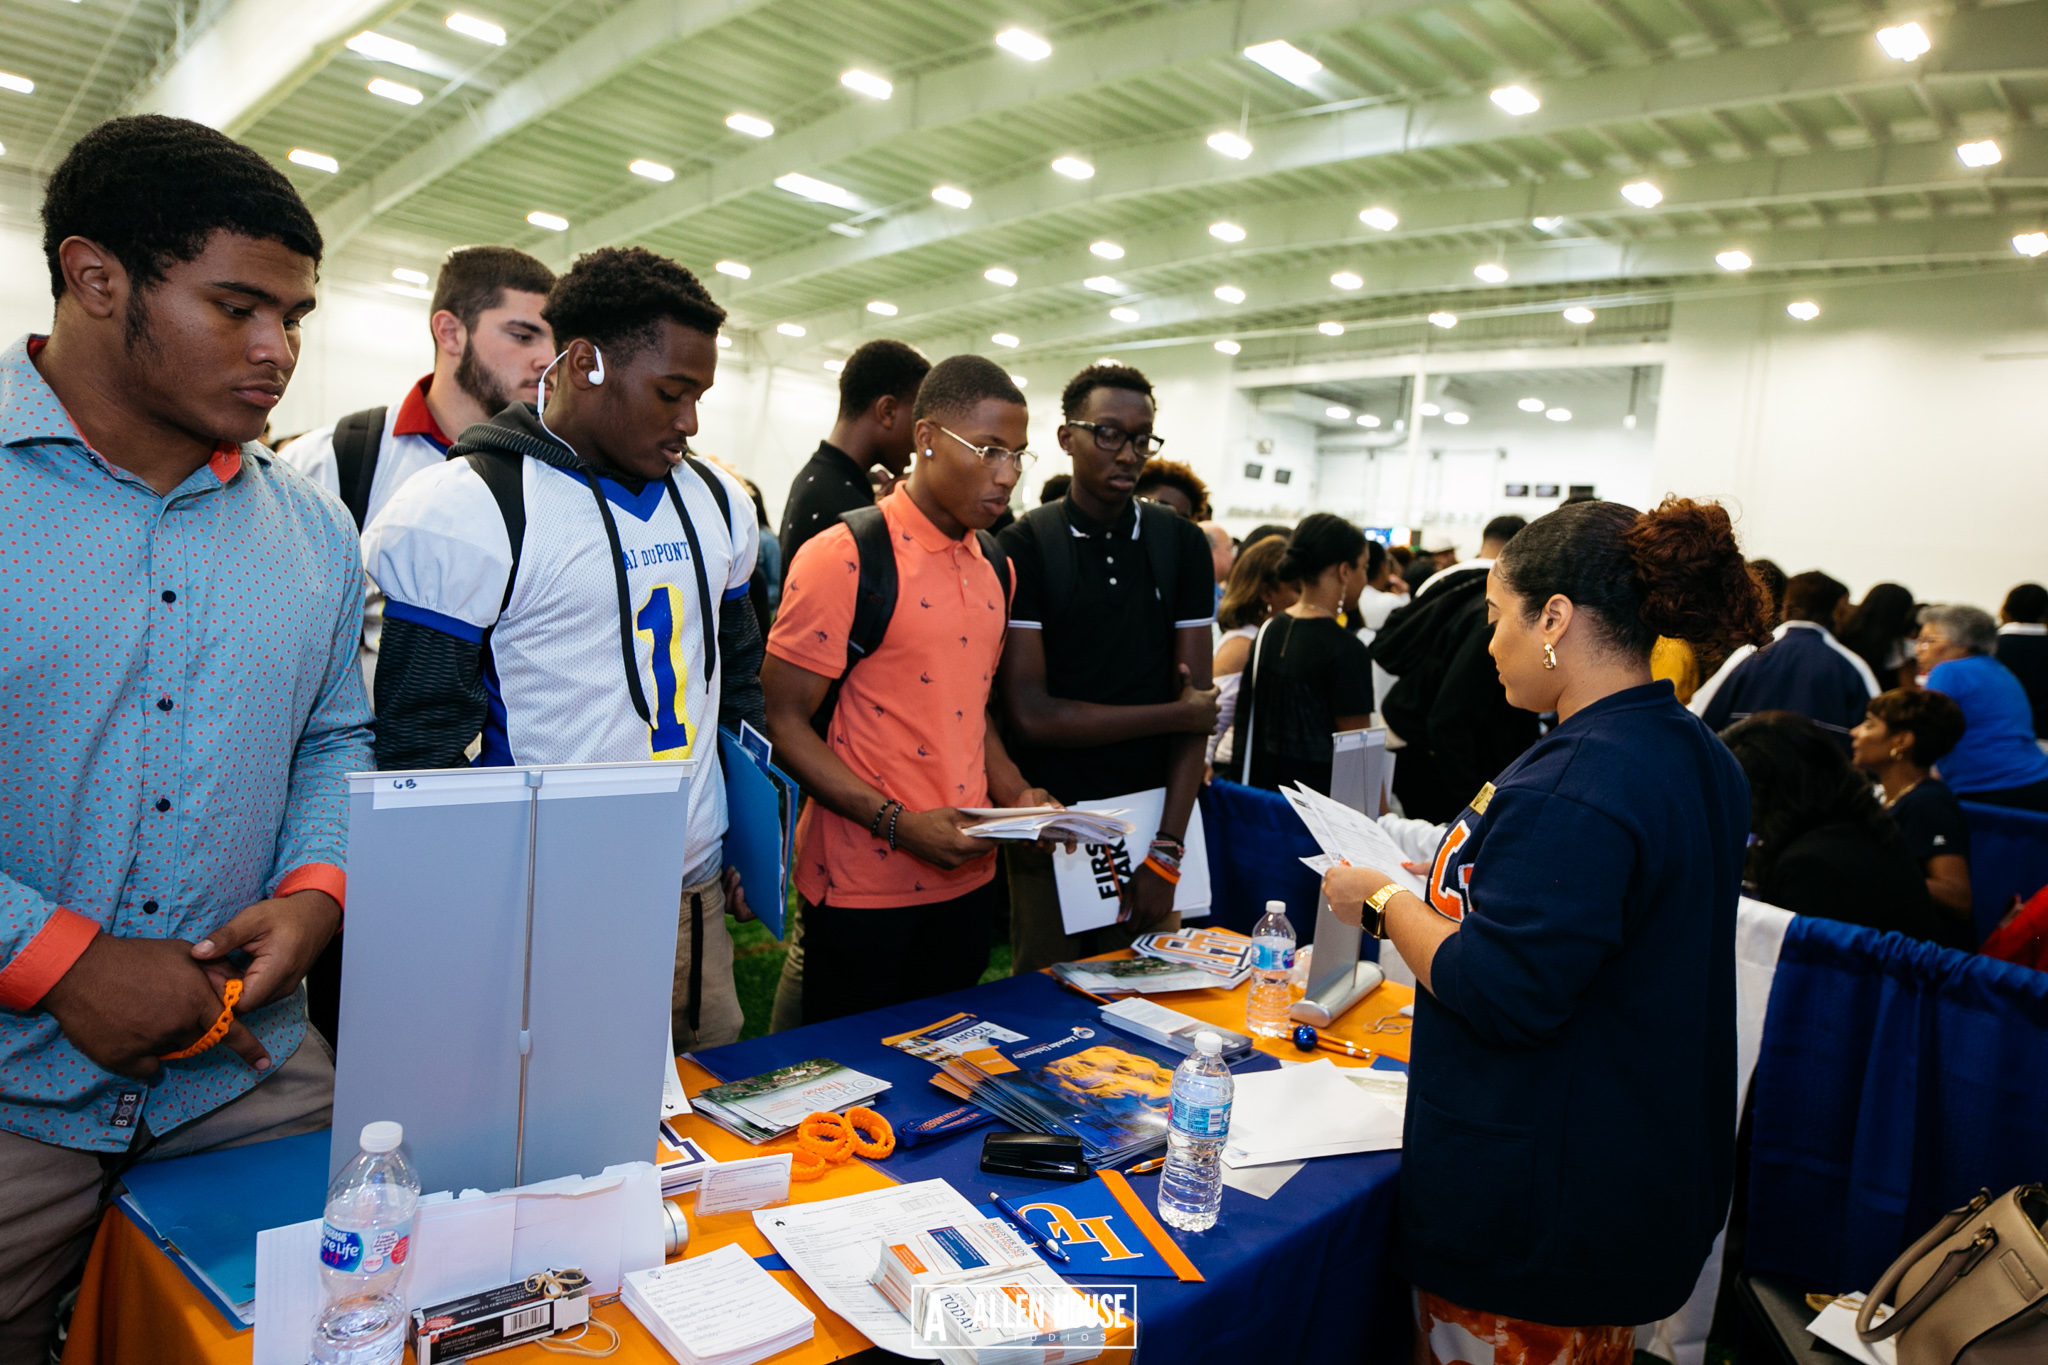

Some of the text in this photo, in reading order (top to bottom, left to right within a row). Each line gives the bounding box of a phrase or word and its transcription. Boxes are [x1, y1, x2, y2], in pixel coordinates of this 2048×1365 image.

[635, 583, 697, 760] 1
[1085, 843, 1119, 900] FIRS
[950, 1025, 992, 1045] TODAY!
[1047, 1034, 1079, 1051] Lincoln
[1012, 1043, 1049, 1060] University
[802, 1078, 880, 1107] OPEN
[336, 1242, 359, 1260] Life
[983, 1222, 1021, 1258] OPEN HOUSE
[989, 1221, 1017, 1245] REGISTER
[1013, 1244, 1028, 1256] FOR
[939, 1293, 981, 1333] TODAY!
